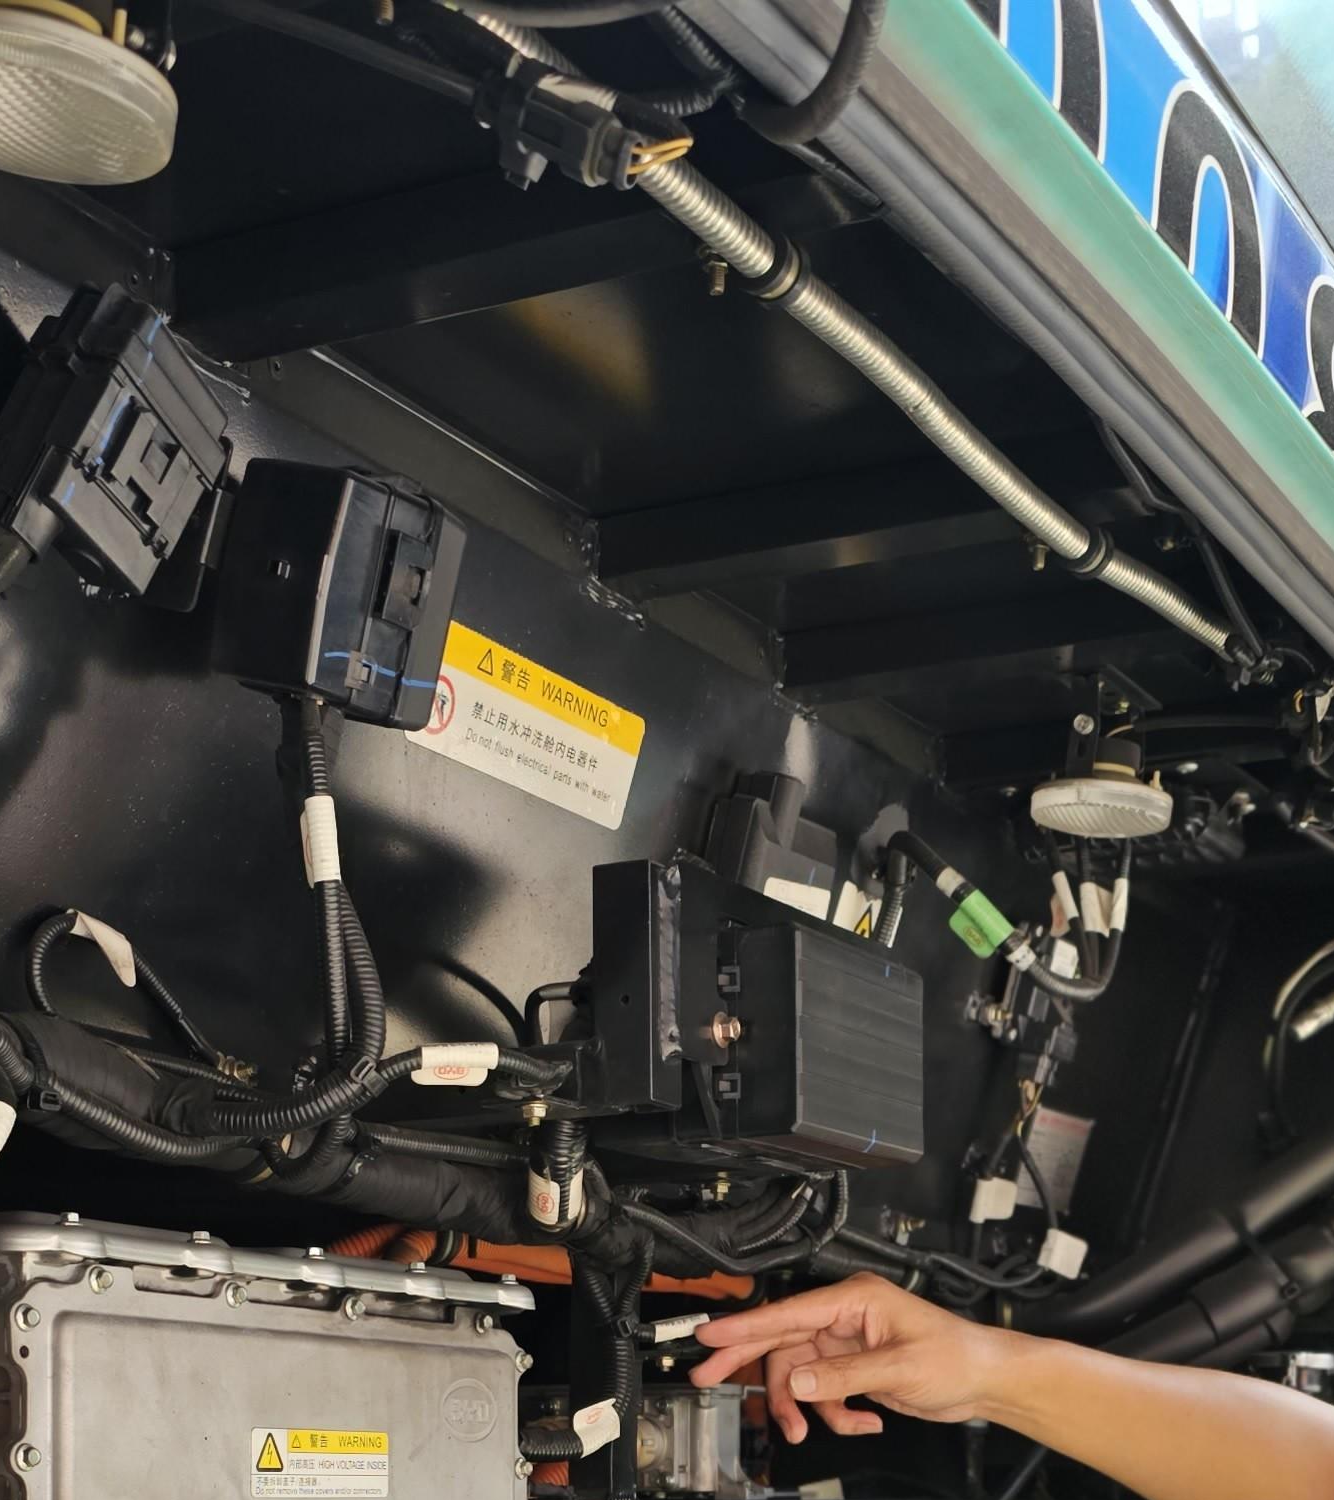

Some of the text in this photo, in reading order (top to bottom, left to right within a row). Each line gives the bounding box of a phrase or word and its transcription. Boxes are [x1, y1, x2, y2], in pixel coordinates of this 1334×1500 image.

[500, 658, 610, 728] 警告 WARNING
[470, 701, 599, 774] 禁止用水冲洗舱内电器件
[494, 740, 514, 760] flush
[516, 750, 551, 776] electrical
[553, 768, 572, 787] parts
[574, 778, 590, 794] with
[591, 786, 612, 803] water
[310, 1433, 382, 1448] 警告 WARNING
[318, 1460, 334, 1470] HIGH
[336, 1460, 365, 1470] VOLTAGE
[366, 1461, 387, 1470] INSIDE
